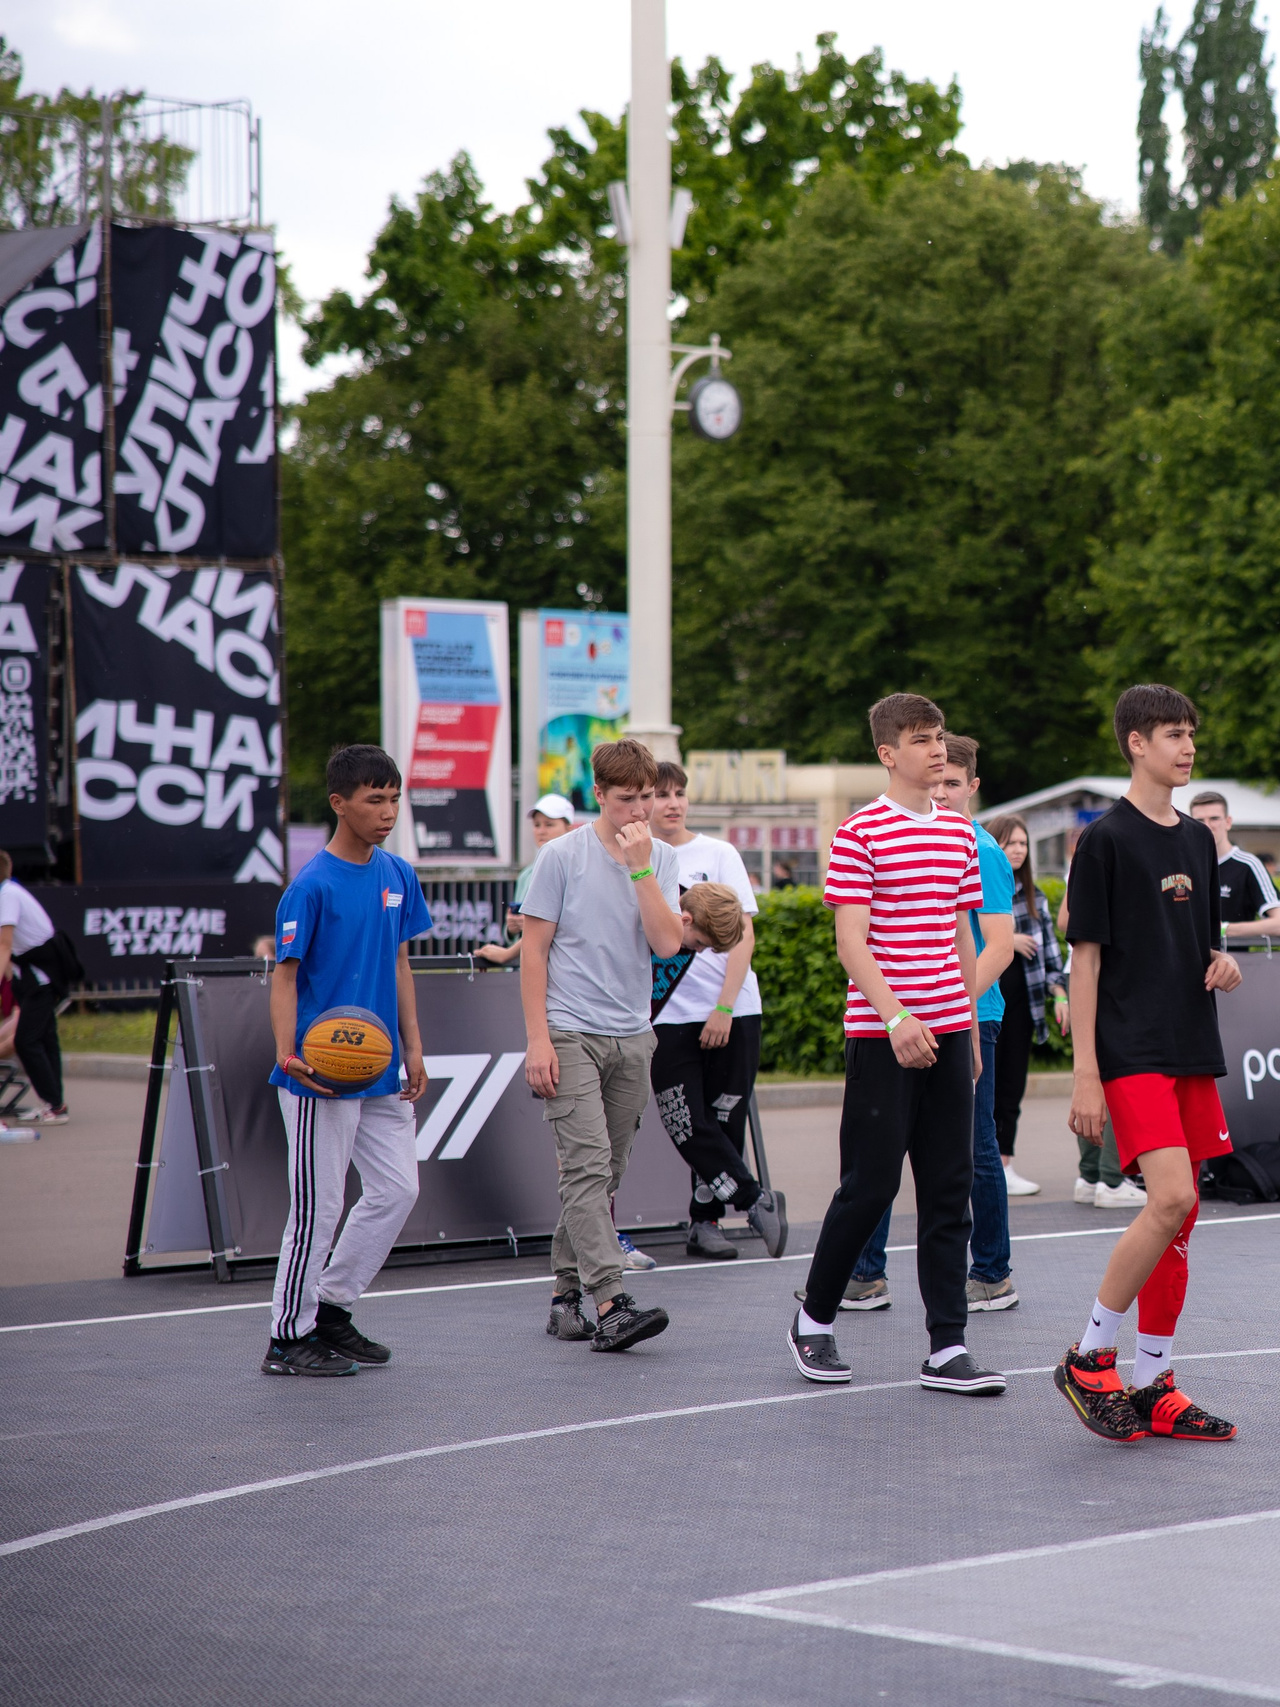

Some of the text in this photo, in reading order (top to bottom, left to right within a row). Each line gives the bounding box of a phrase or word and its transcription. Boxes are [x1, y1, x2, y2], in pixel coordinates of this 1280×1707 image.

[84, 906, 227, 935] EXTREME
[107, 931, 203, 956] TEAM
[660, 1095, 686, 1117] ANT
